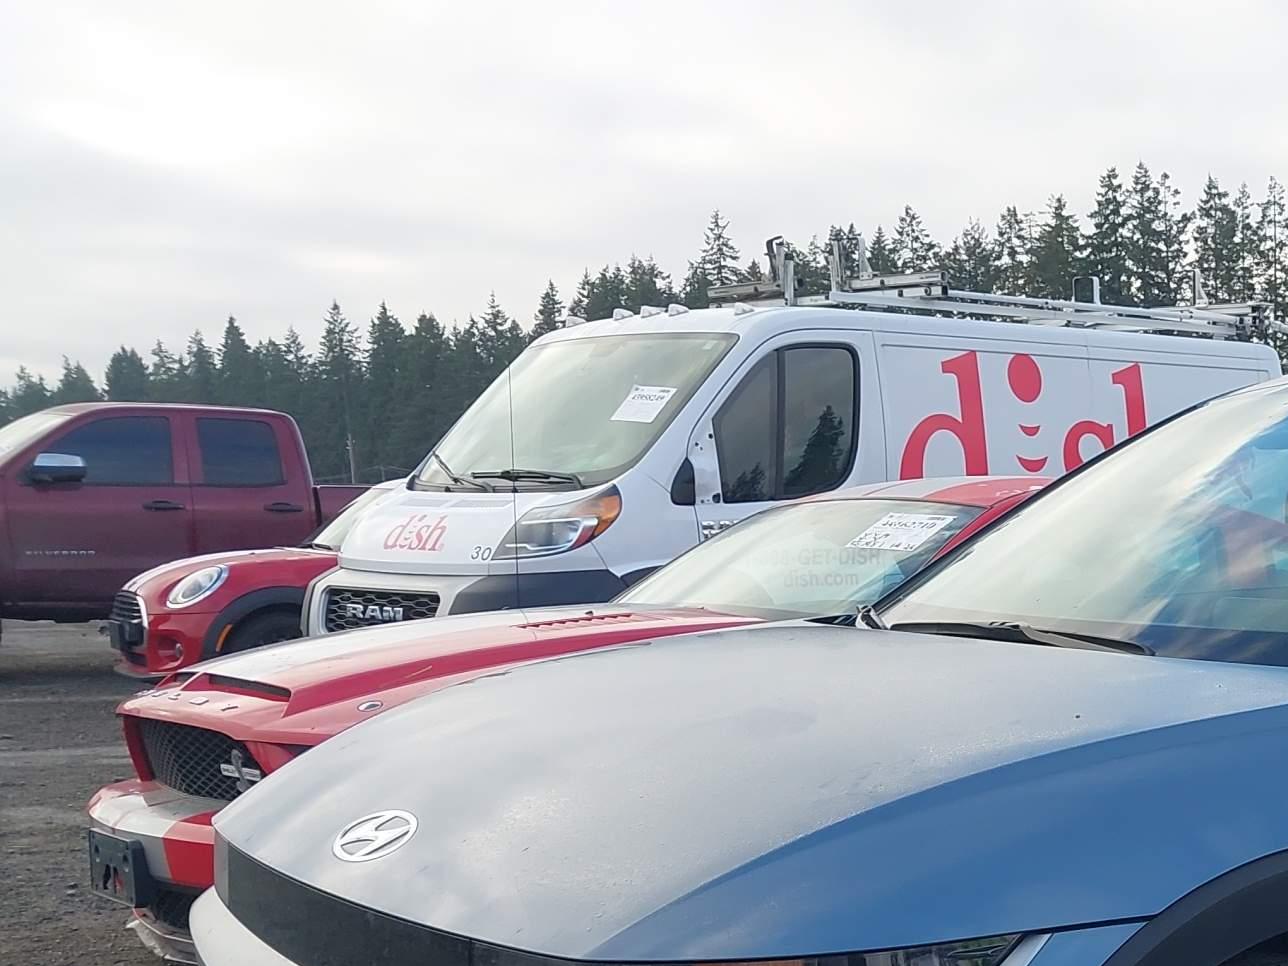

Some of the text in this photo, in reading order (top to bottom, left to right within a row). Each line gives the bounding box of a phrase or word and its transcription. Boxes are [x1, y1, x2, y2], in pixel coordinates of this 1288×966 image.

[384, 514, 448, 551] dish
[470, 546, 492, 561] 30
[783, 569, 859, 588] dish.com
[346, 603, 404, 621] RAM
